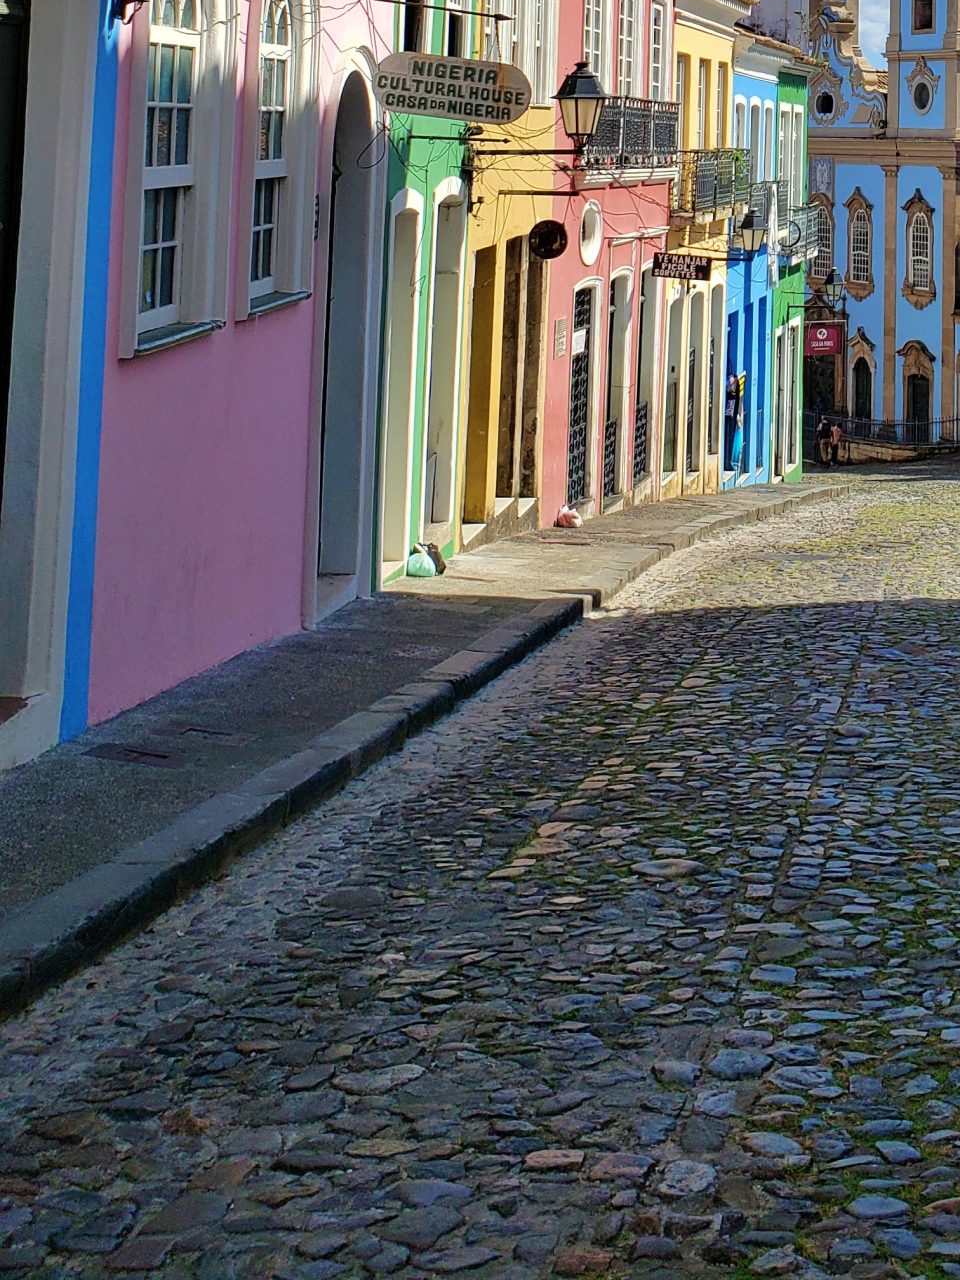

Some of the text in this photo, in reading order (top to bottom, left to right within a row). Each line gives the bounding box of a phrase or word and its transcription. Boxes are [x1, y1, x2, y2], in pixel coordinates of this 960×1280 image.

[412, 61, 497, 85] NIGERIA
[377, 74, 525, 106] CULTURAL HOUSE
[385, 93, 512, 121] CASA DA NIGERIA
[654, 268, 696, 278] SORVETES
